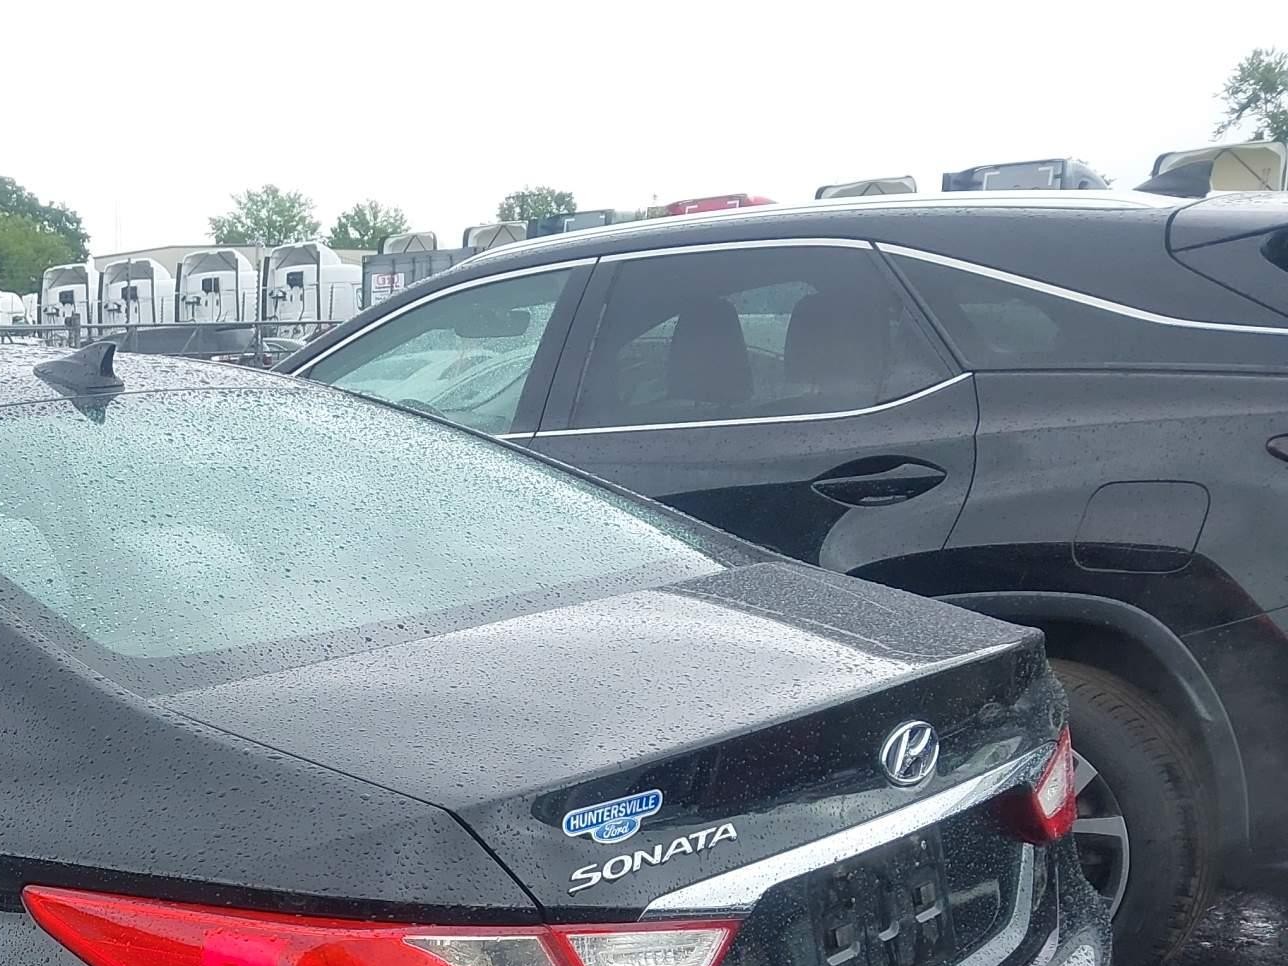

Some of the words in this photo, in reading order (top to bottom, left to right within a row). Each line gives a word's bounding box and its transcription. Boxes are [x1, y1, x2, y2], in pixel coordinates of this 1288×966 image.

[569, 794, 657, 831] HUNTERSVILLE
[602, 820, 631, 839] Ford
[568, 822, 738, 894] SONATA
